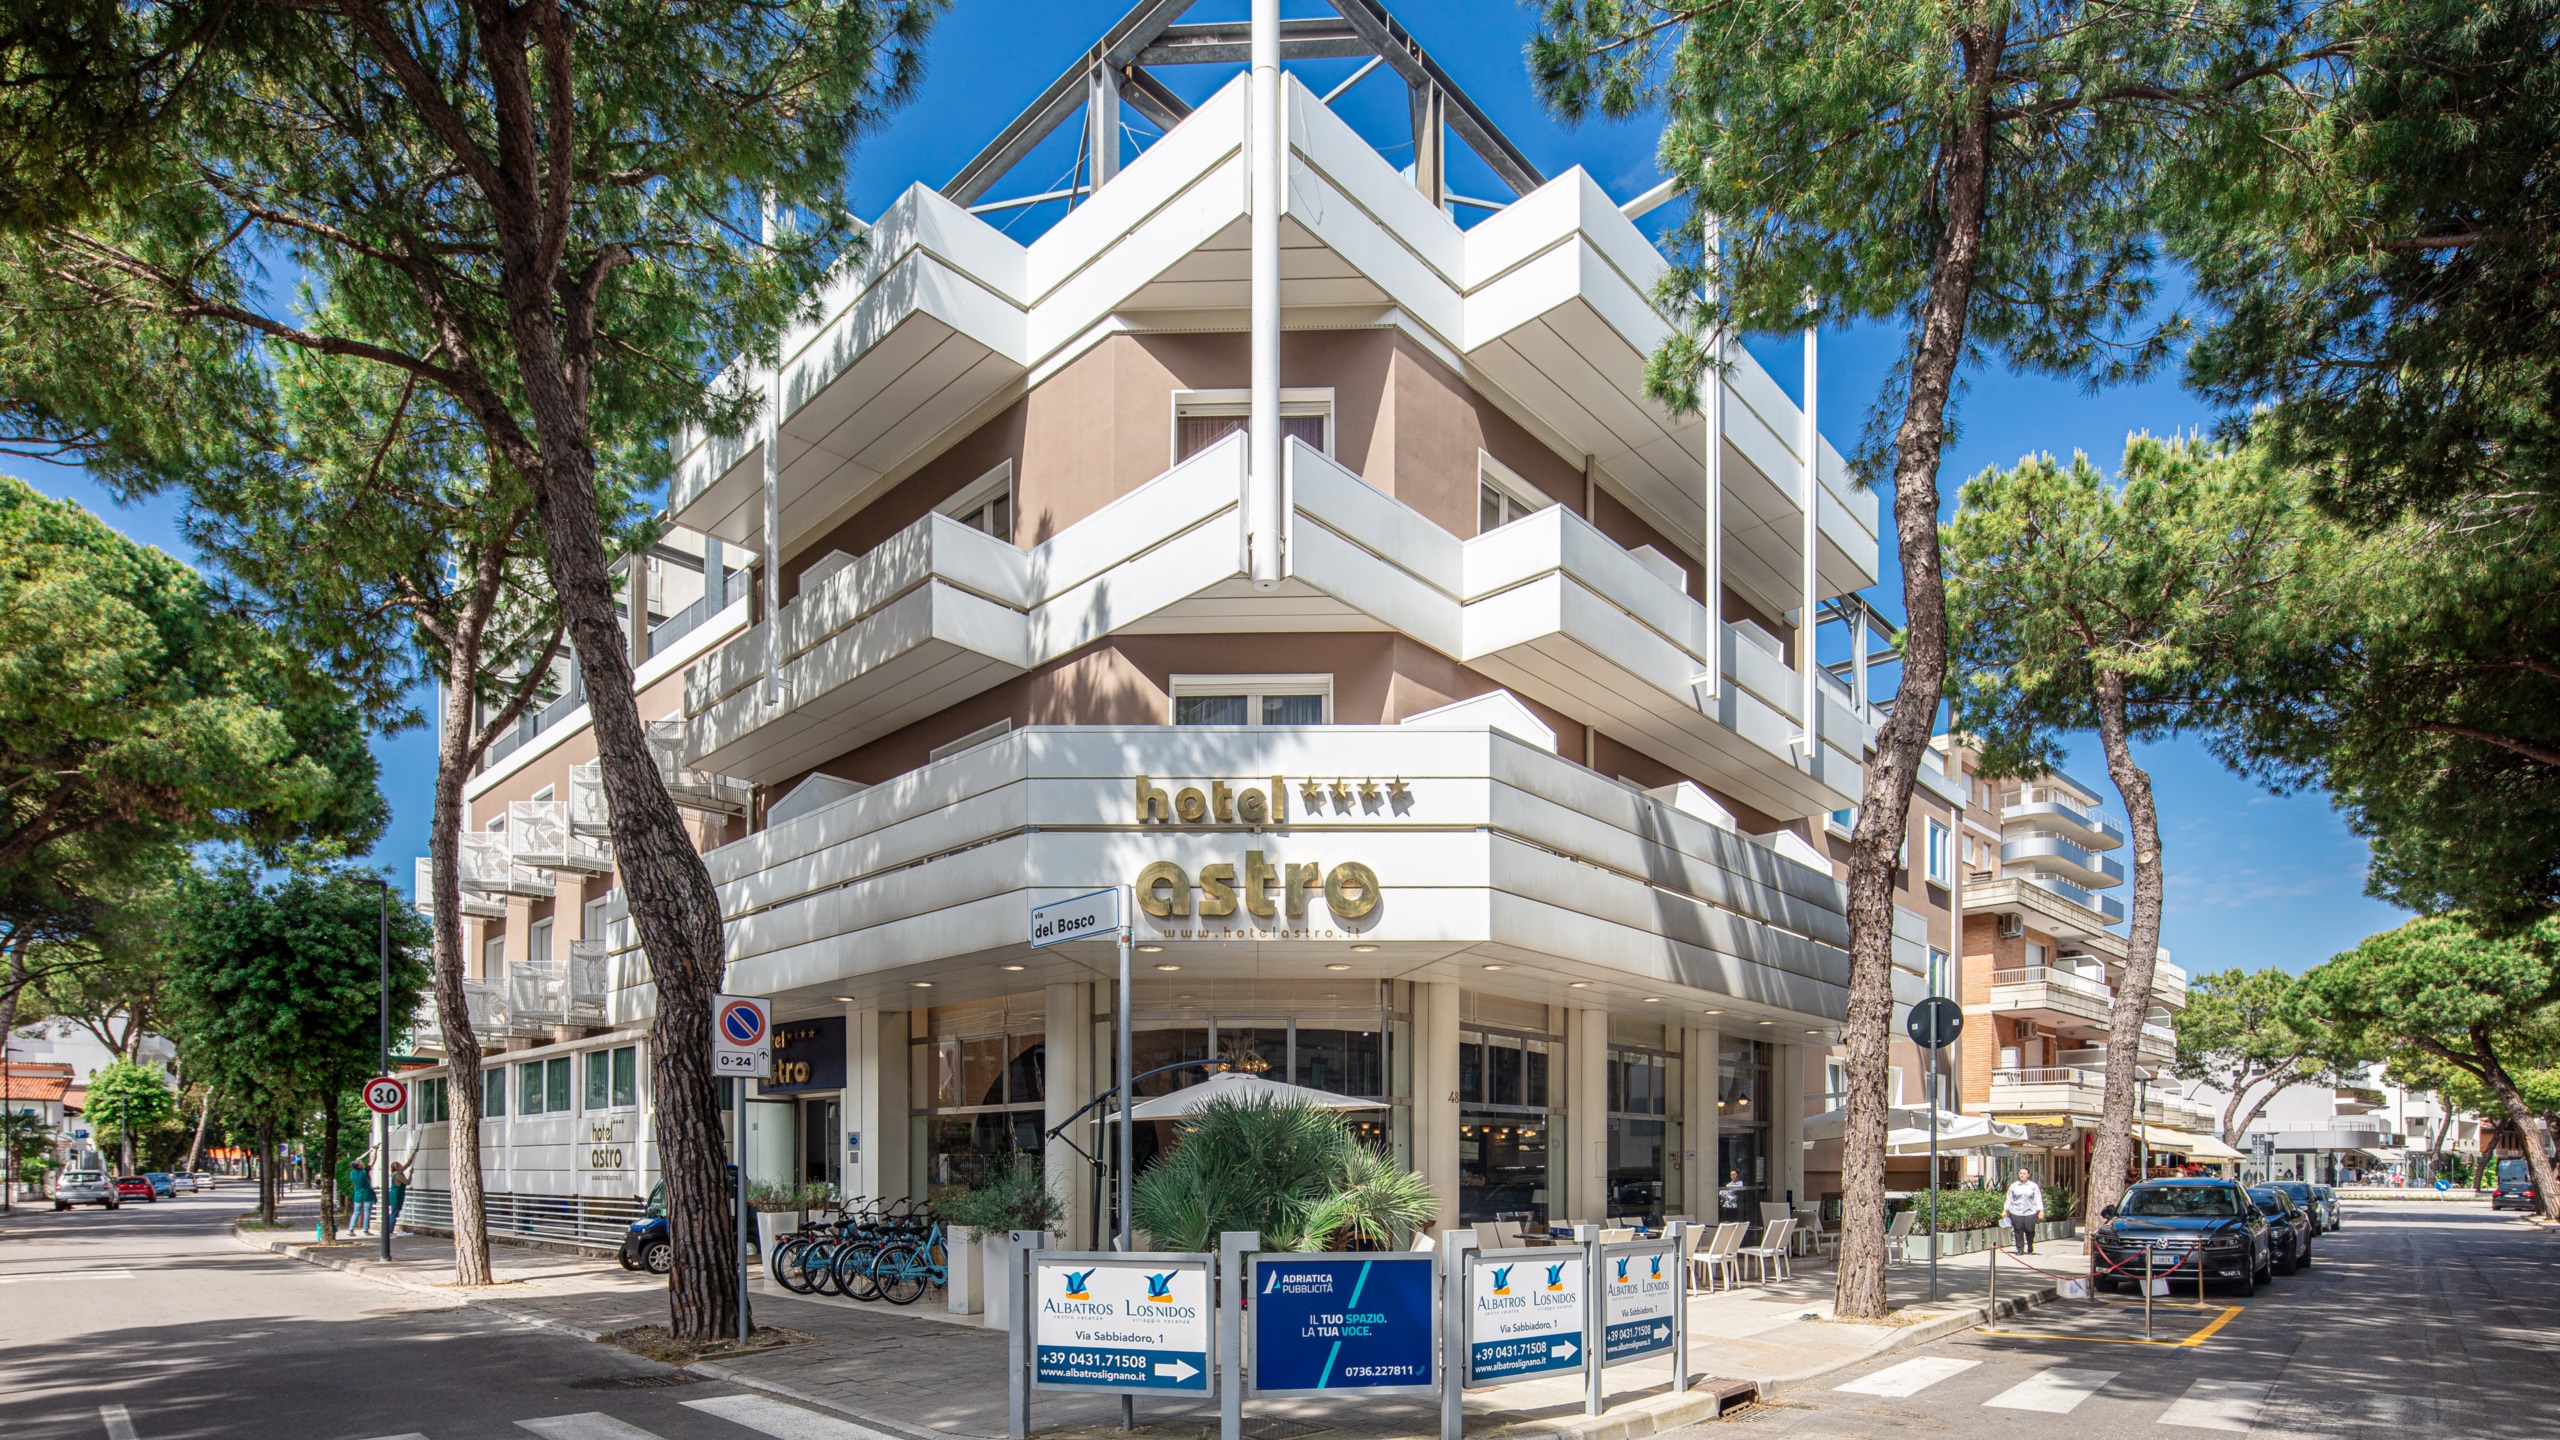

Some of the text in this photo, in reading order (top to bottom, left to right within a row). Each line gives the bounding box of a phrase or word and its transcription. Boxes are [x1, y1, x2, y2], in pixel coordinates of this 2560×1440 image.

[1136, 775, 1284, 822] hotel
[1135, 850, 1380, 919] astro
[1034, 911, 1044, 920] via
[1035, 914, 1096, 938] del Bosco
[1163, 926, 1361, 939] www.hotelastro.it
[374, 1088, 397, 1103] 30
[1448, 1091, 1458, 1103] 48
[592, 1121, 613, 1141] hotel
[592, 1145, 622, 1168] astro
[1282, 1274, 1333, 1283] ADRIATICA
[1282, 1283, 1333, 1294] PUBBLICITÀ
[1043, 1297, 1114, 1316] ALBATROS
[1477, 1295, 1526, 1311] ALBATROS
[1621, 1309, 1629, 1317] Via
[1655, 1304, 1658, 1312] 1
[1309, 1313, 1387, 1325] IL TUO SPAZIO.
[1500, 1319, 1558, 1334] Via Sabbiadoro, 1
[1075, 1331, 1164, 1344] Via Sabbiadoro, 1
[1302, 1326, 1372, 1337] LA TUA VOCE.
[1607, 1324, 1651, 1342] +39 0431.71508
[1475, 1341, 1547, 1361] +39 0431.71508
[1041, 1352, 1147, 1368] +39 0431.71508
[1475, 1356, 1547, 1373] www.albatroslignano.it
[1040, 1368, 1146, 1382] www.albatroslignano.it
[1345, 1365, 1413, 1377] 0736.227811
